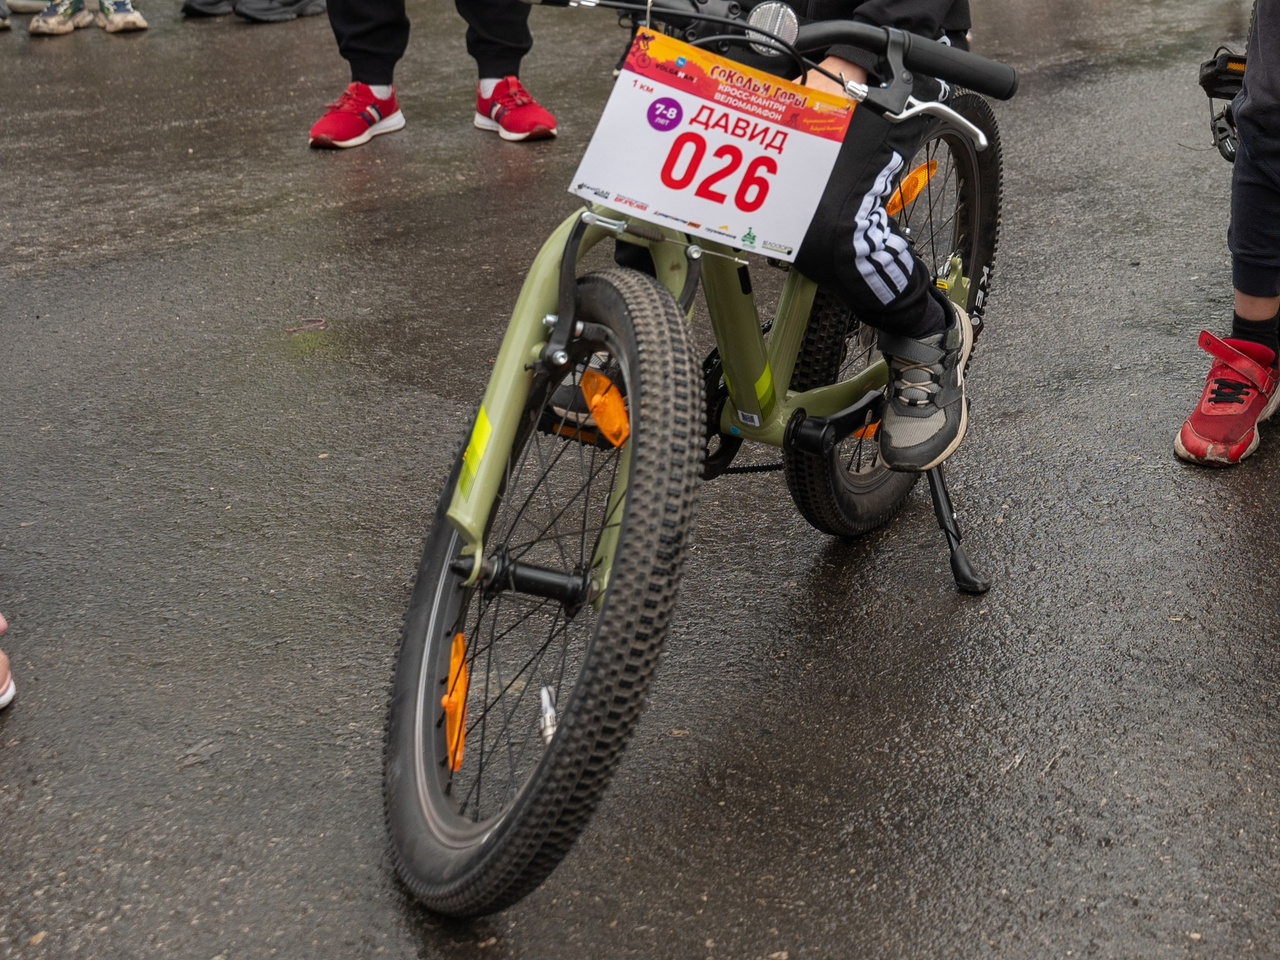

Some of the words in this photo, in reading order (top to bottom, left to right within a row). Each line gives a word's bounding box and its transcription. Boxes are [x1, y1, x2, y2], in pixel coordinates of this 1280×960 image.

[632, 80, 638, 88] 1
[714, 92, 783, 121] ВЕЛОМАРАФОН
[718, 84, 786, 112] КРОСС-КАНТРИ
[773, 87, 808, 108] ГОРЫ
[654, 117, 670, 126] лет
[655, 103, 678, 120] 7-8
[689, 104, 788, 155] ДАВИД
[660, 131, 778, 213] 026
